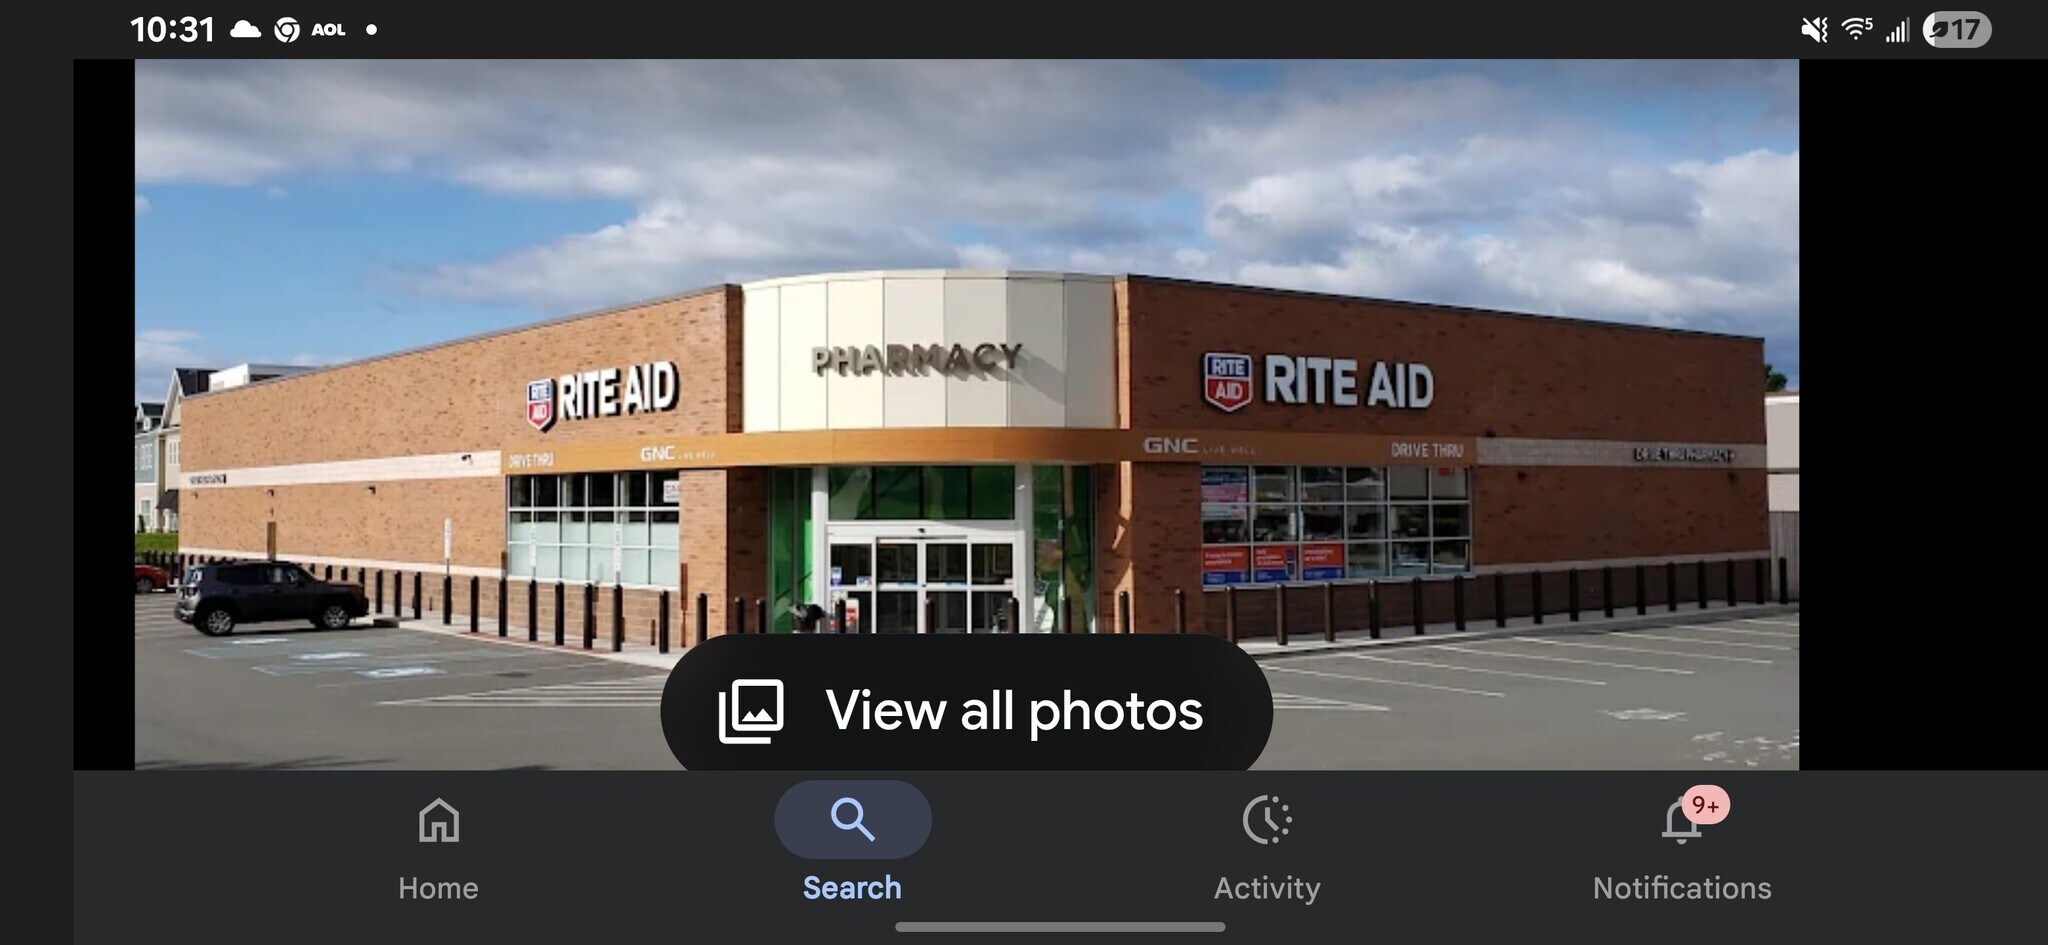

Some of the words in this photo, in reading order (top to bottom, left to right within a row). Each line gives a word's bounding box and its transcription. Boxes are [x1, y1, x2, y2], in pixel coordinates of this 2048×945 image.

[131, 16, 213, 43] 10:31
[310, 22, 346, 37] AOL
[1864, 17, 1874, 31] 5
[1952, 18, 1981, 41] 17
[811, 342, 1023, 377] PHARMACY
[1211, 357, 1246, 376] RITE
[531, 382, 551, 400] RITE
[558, 367, 620, 420] RITE
[622, 361, 678, 413] AID
[1214, 382, 1243, 401] AID
[1265, 354, 1358, 406] RITE
[1367, 360, 1434, 410] AID
[532, 405, 548, 419] AID
[640, 445, 676, 463] GNC
[1143, 436, 1198, 454] GNC
[1392, 442, 1429, 457] DRIVE
[1433, 442, 1464, 458] THRU
[508, 453, 532, 469] DRIVE
[533, 452, 555, 467] THRU
[825, 688, 948, 731] View
[961, 689, 1013, 731] all
[1030, 689, 1204, 742] photos
[1692, 795, 1720, 815] 9+
[399, 876, 479, 900] Home
[803, 873, 902, 900] Search
[1214, 874, 1322, 906] Activity
[1594, 874, 1772, 900] Notifications
